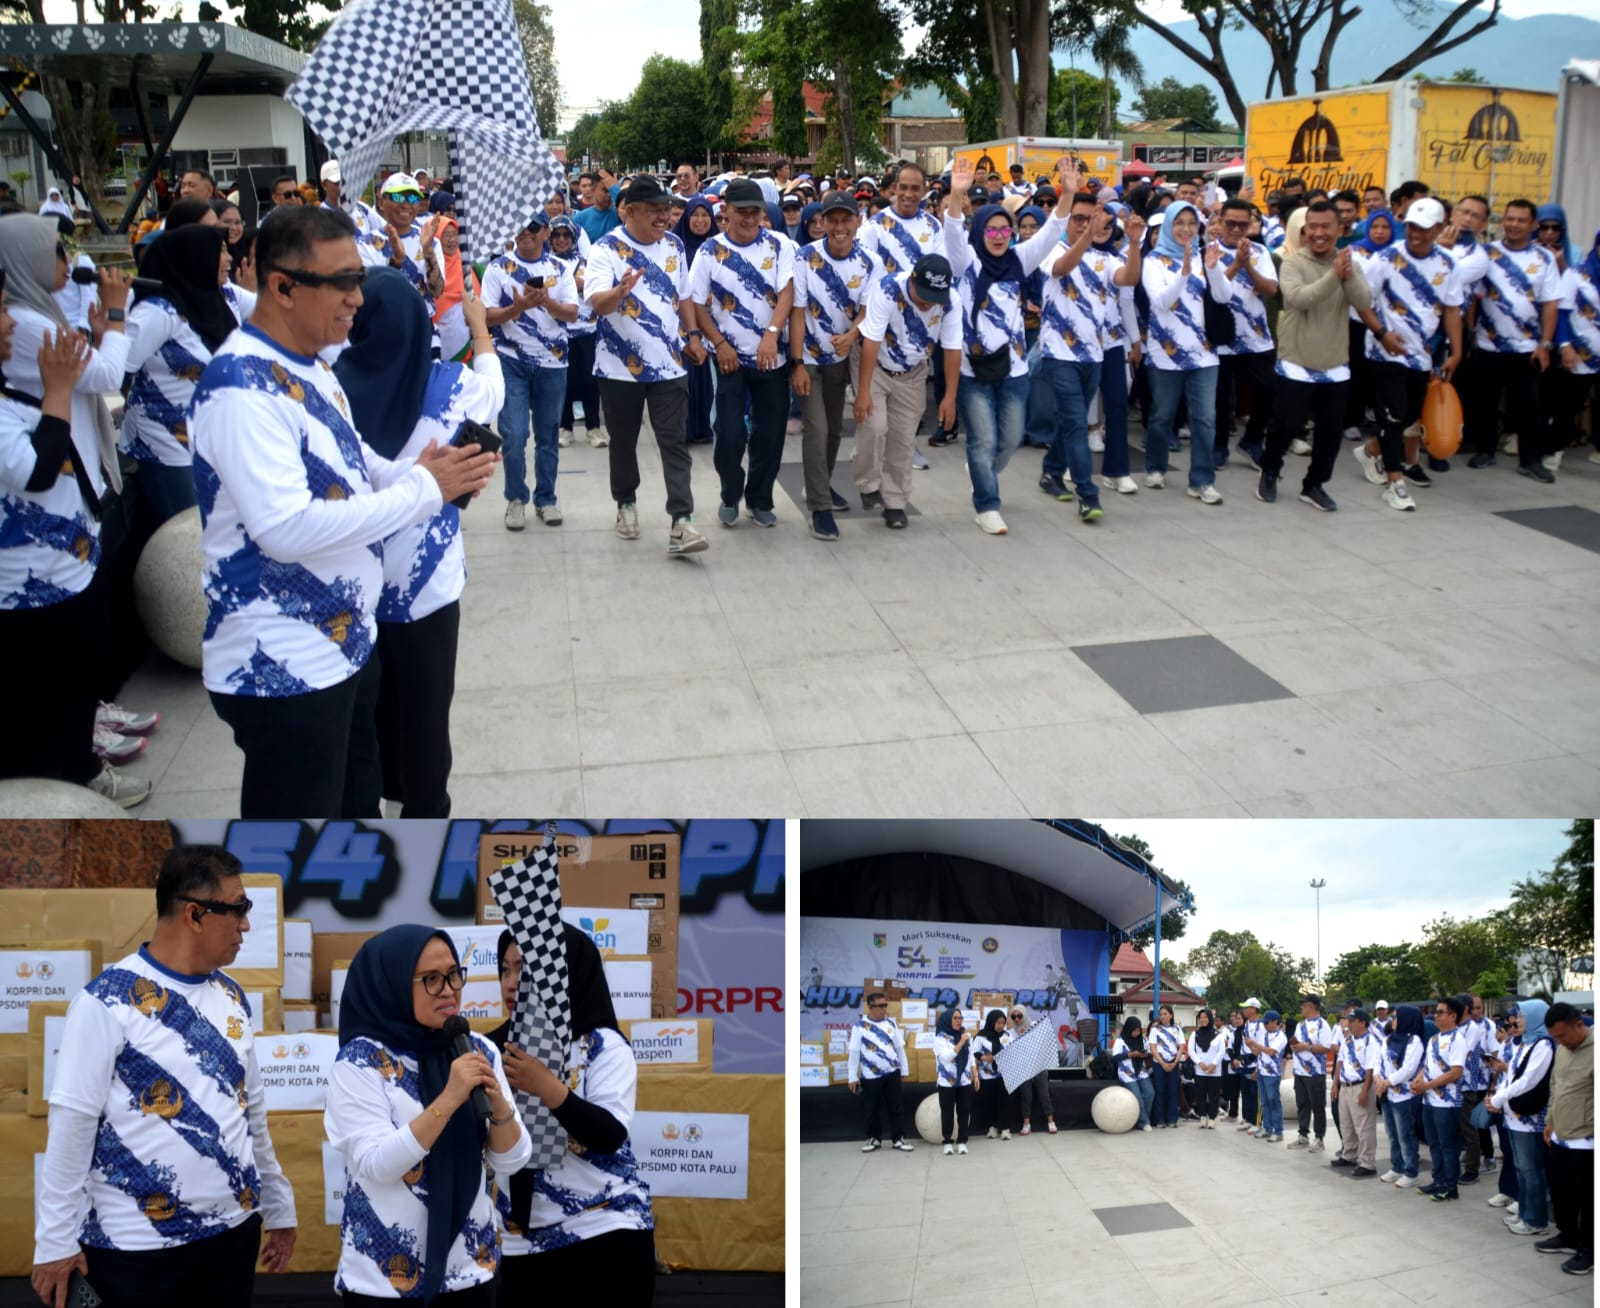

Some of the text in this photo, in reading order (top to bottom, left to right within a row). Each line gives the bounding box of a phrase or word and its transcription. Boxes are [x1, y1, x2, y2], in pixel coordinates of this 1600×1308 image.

[1429, 140, 1470, 168] Fat
[588, 933, 616, 947] en
[902, 930, 972, 944] Mari Sukseskan
[897, 944, 932, 969] 54
[896, 971, 932, 979] KORPRI
[6, 986, 66, 996] KORPRI DAN
[805, 986, 864, 1008] HUT
[632, 1035, 682, 1048] mandiri
[633, 1048, 672, 1062] taspen
[260, 1064, 320, 1075] KORPRI DAN
[289, 1077, 313, 1087] KOTA
[650, 1148, 713, 1159] KORPRI DAN
[680, 1163, 706, 1173] KOTA
[709, 1164, 737, 1175] PALU
